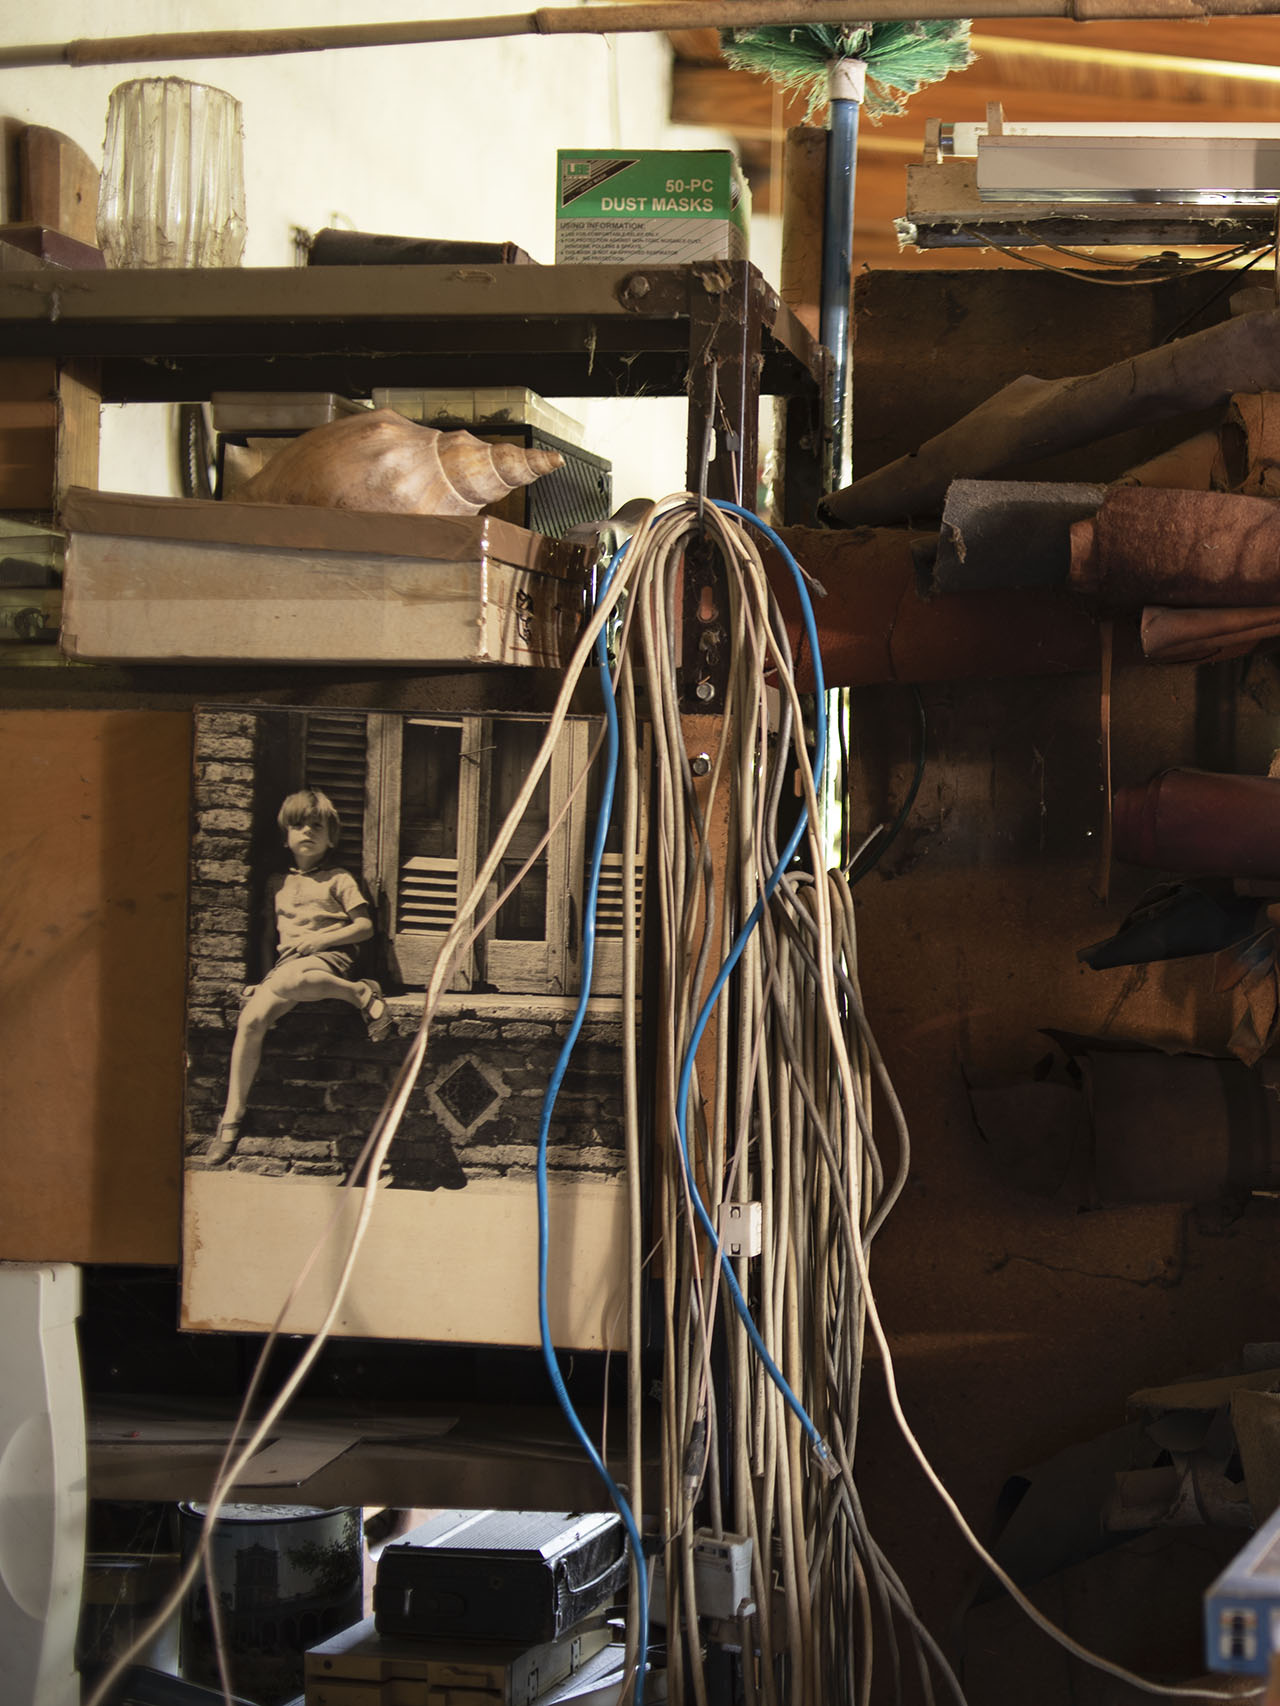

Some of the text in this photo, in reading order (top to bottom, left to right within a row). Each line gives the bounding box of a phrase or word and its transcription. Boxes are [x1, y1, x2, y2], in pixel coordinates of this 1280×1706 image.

[665, 179, 714, 193] 50-PC
[601, 197, 714, 212] DUST MASKS
